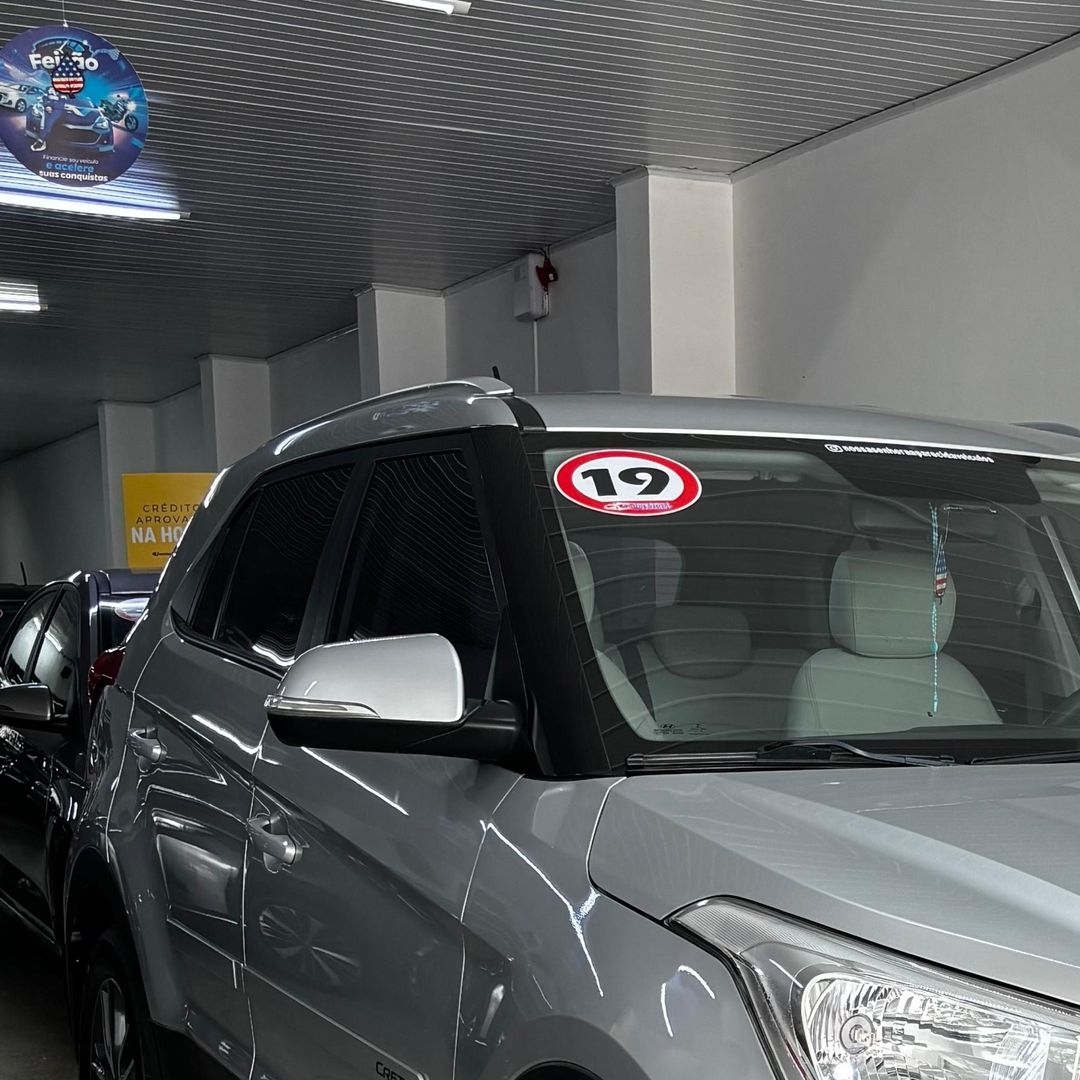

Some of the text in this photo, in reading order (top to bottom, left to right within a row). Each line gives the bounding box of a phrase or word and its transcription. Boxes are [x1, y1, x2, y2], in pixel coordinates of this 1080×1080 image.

[28, 50, 99, 71] Feião
[54, 163, 94, 173] acelere
[39, 170, 109, 182] suas conquistas
[581, 467, 670, 496] 19
[136, 515, 191, 525] APROVA
[131, 526, 157, 544] NA
